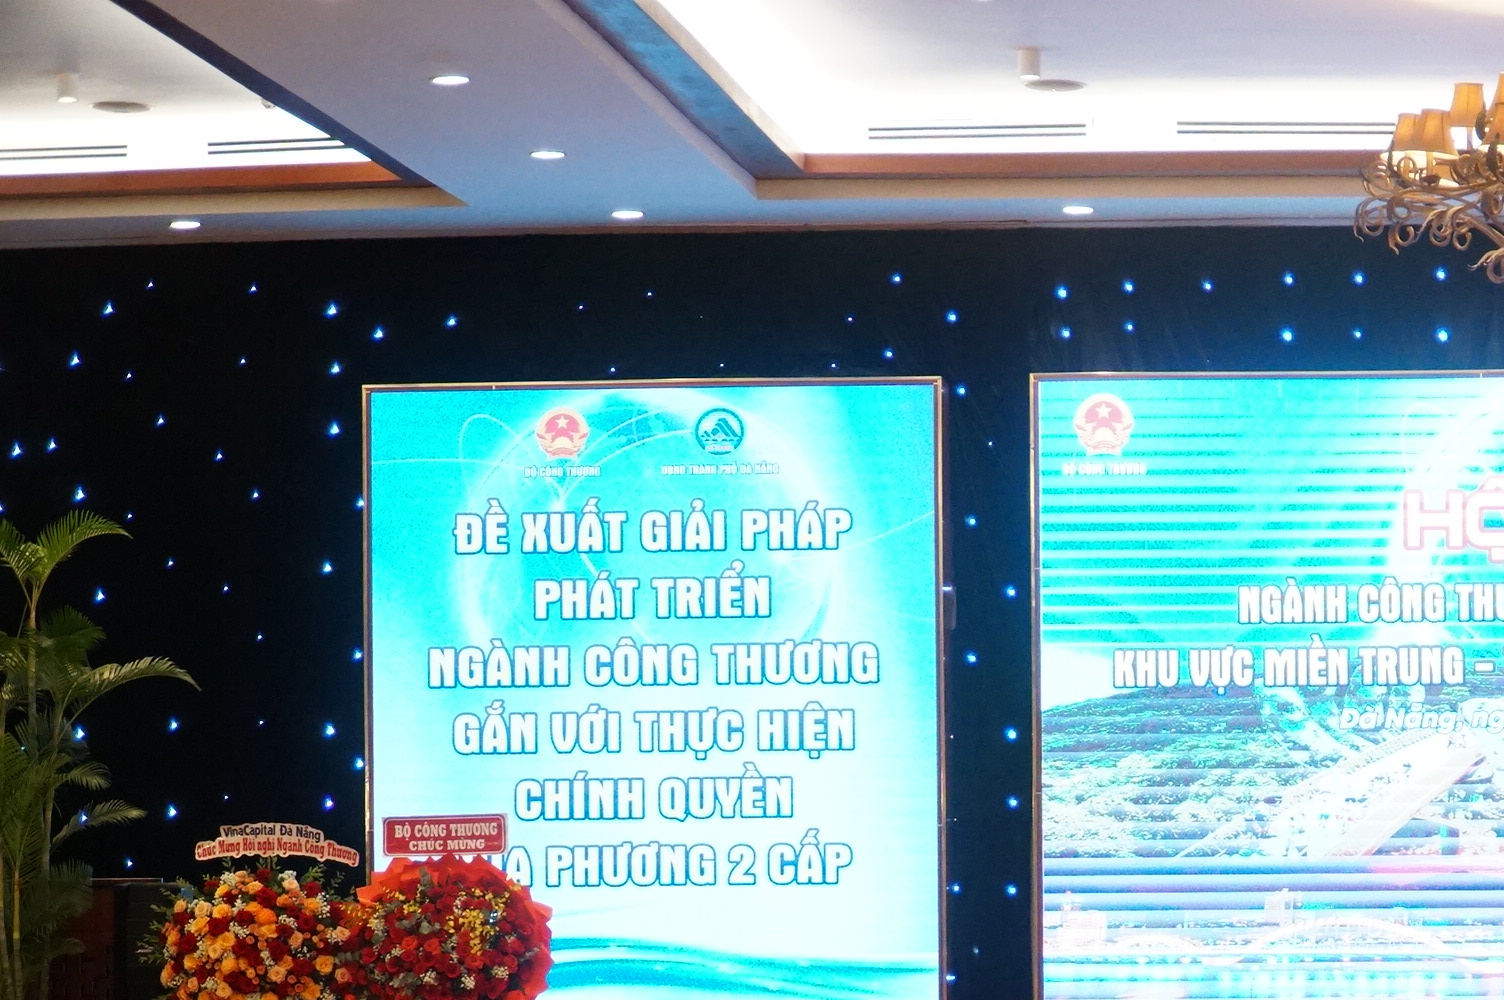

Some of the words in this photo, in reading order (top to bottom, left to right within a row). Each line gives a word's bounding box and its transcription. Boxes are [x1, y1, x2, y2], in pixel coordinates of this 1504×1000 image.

[453, 497, 509, 555] ĐỀ
[521, 496, 628, 554] XUẤT
[640, 498, 727, 553] GIẢI
[741, 500, 852, 551] PHÁP
[533, 571, 638, 621] PHÁT
[650, 559, 772, 619] TRIỂN
[1237, 576, 1348, 624] NGÀNH
[1358, 576, 1446, 623] CÔNG
[428, 638, 570, 688] NGÀNH
[583, 636, 699, 686] CÔNG
[710, 638, 880, 685] THƯƠNG
[1113, 647, 1180, 688] KHU
[1188, 643, 1255, 696] VỰC
[1264, 632, 1349, 688] MIỀN
[1357, 644, 1465, 687] TRUNG
[453, 699, 538, 755] GẮN
[550, 703, 621, 754] VỚI
[634, 707, 744, 760] THỰC
[757, 701, 855, 759] HIỆN
[1339, 704, 1379, 730] Đà
[514, 770, 645, 821] CHÍNH
[658, 761, 794, 823] QUYỀN
[222, 825, 276, 838] VinaCapital
[279, 825, 293, 836] Đà
[394, 823, 411, 840] BỘ
[414, 821, 447, 838] CÔNG
[408, 837, 443, 851] CHÚC
[545, 841, 717, 888] PHƯƠNG
[728, 844, 757, 885] 2
[767, 828, 853, 885] CẤP
